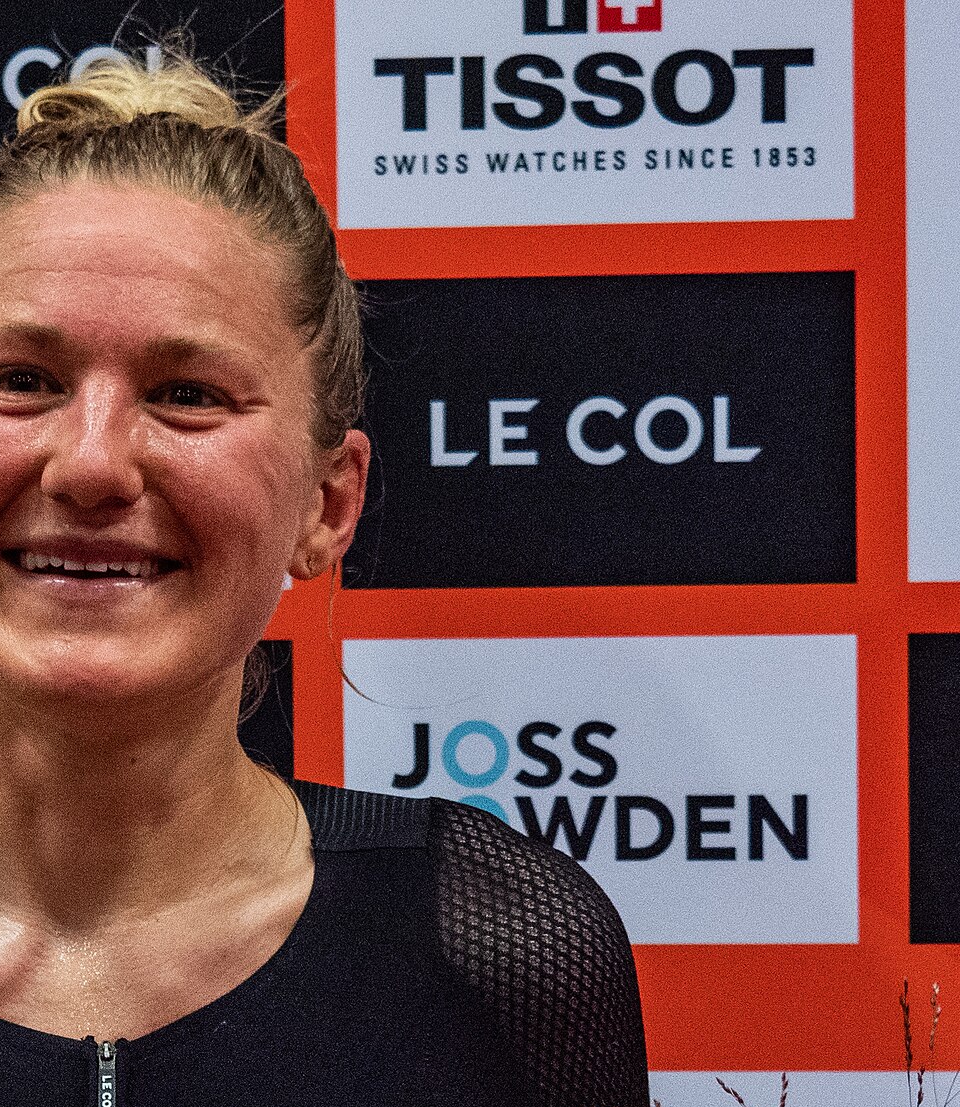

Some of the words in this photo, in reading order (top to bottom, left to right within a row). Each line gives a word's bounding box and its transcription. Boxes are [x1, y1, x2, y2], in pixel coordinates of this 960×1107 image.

[374, 48, 815, 131] TISSOT
[374, 154, 469, 176] SWISS
[486, 150, 626, 173] WATCHES
[645, 147, 735, 170] SINCE
[753, 146, 817, 167] 1853
[429, 398, 540, 468] LE
[565, 395, 762, 466] COL
[391, 720, 618, 790] JOSS
[101, 1075, 113, 1090] LE
